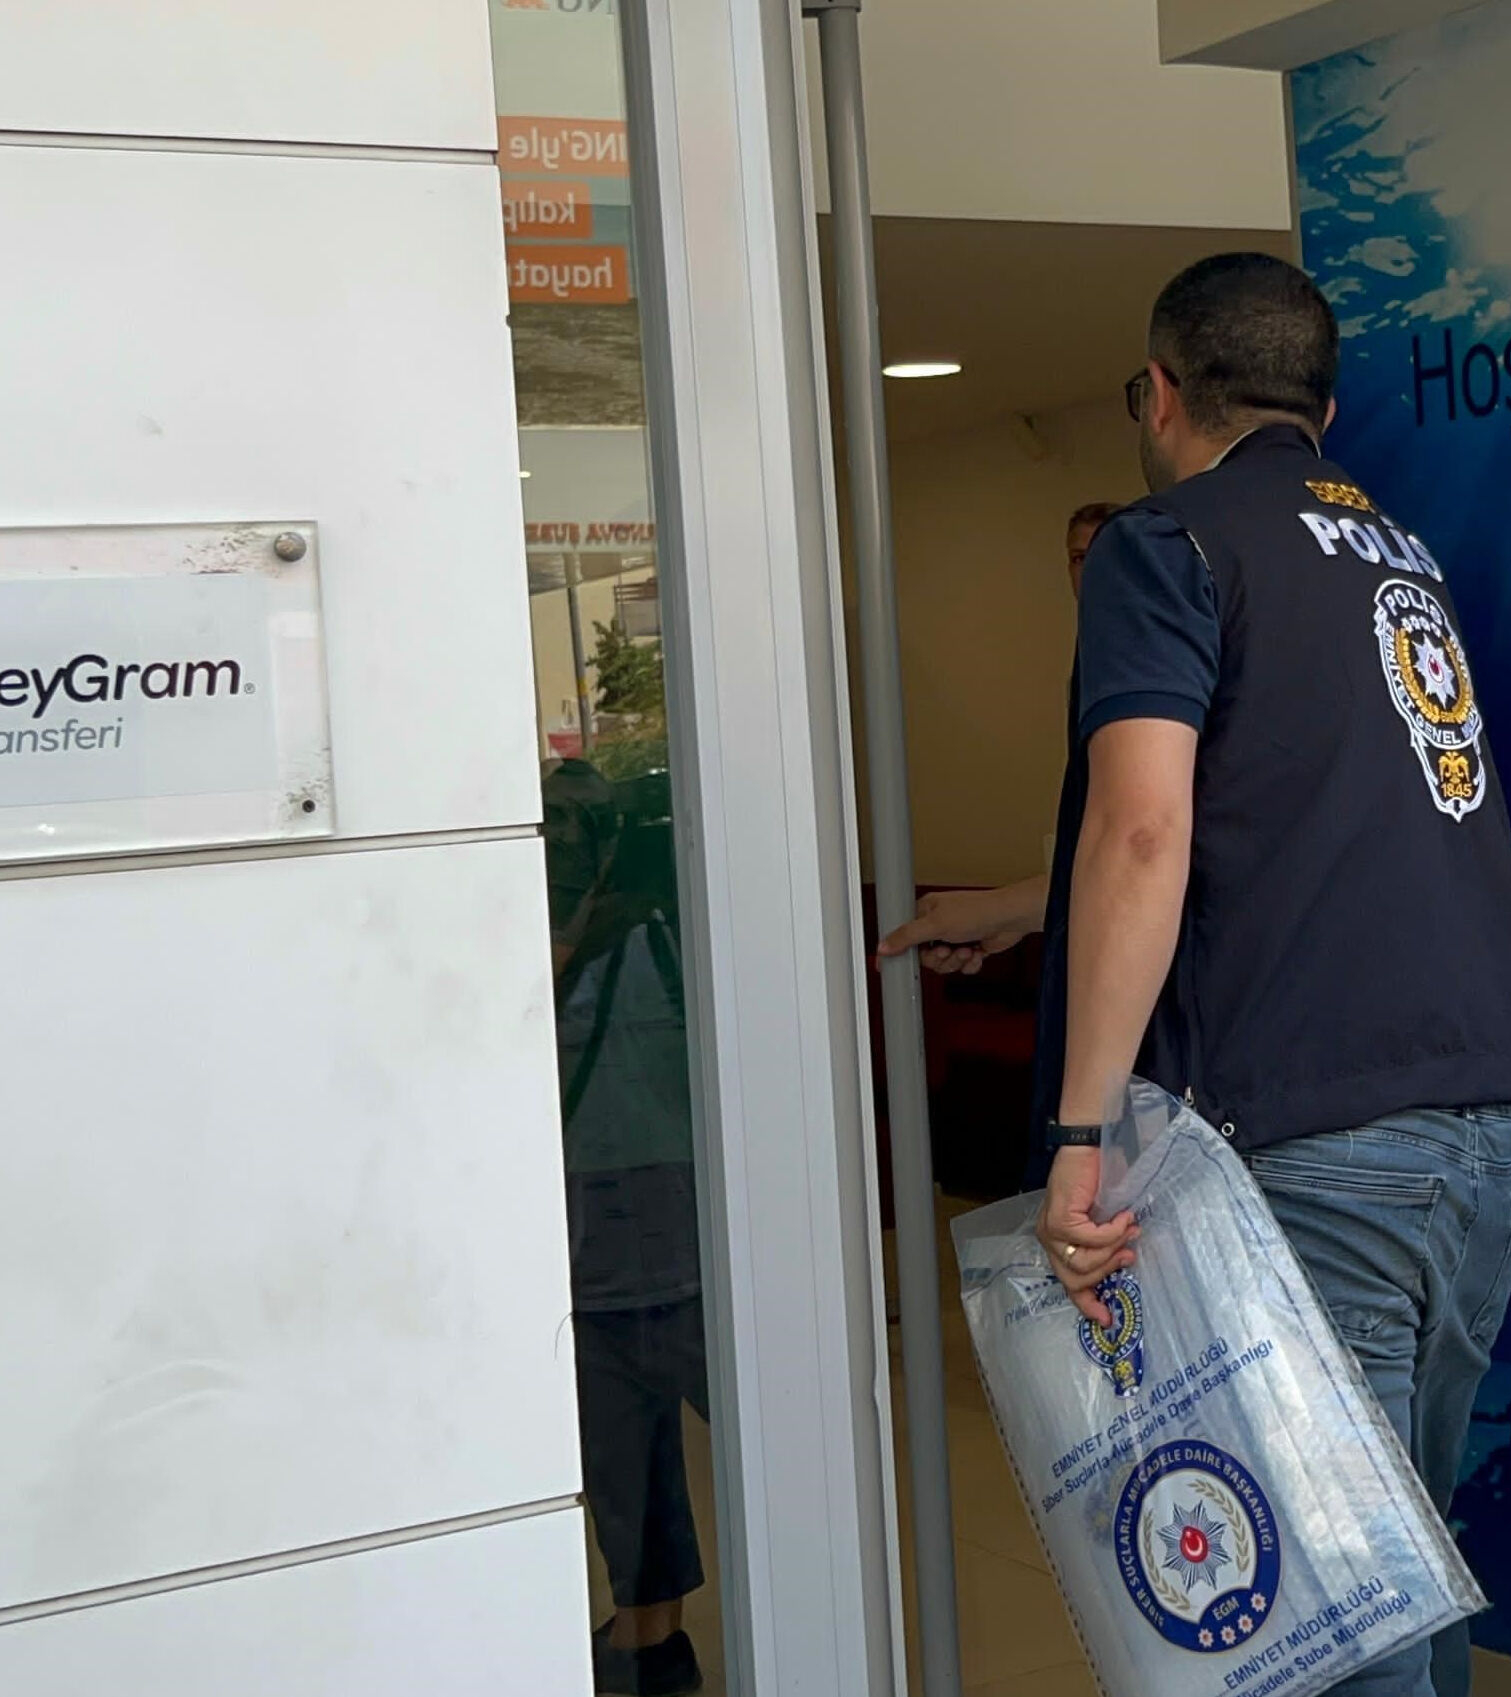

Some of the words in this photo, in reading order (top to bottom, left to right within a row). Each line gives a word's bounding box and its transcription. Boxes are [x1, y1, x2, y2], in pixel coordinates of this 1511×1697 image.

[1298, 513, 1444, 582] POLİS
[1440, 782, 1472, 798] 1845
[1201, 1339, 1274, 1393] Başkanlığı
[1052, 1433, 1103, 1479] EMNİYET
[1150, 1336, 1230, 1410] MÜDÜRLÜĞÜ
[1213, 1595, 1241, 1622] EGM
[1224, 1640, 1288, 1690] EMNİYET
[1285, 1575, 1385, 1649] MÜDÜRLÜĞÜ
[1294, 1642, 1333, 1673] Şube
[1331, 1588, 1413, 1649] Müdürlüğü
